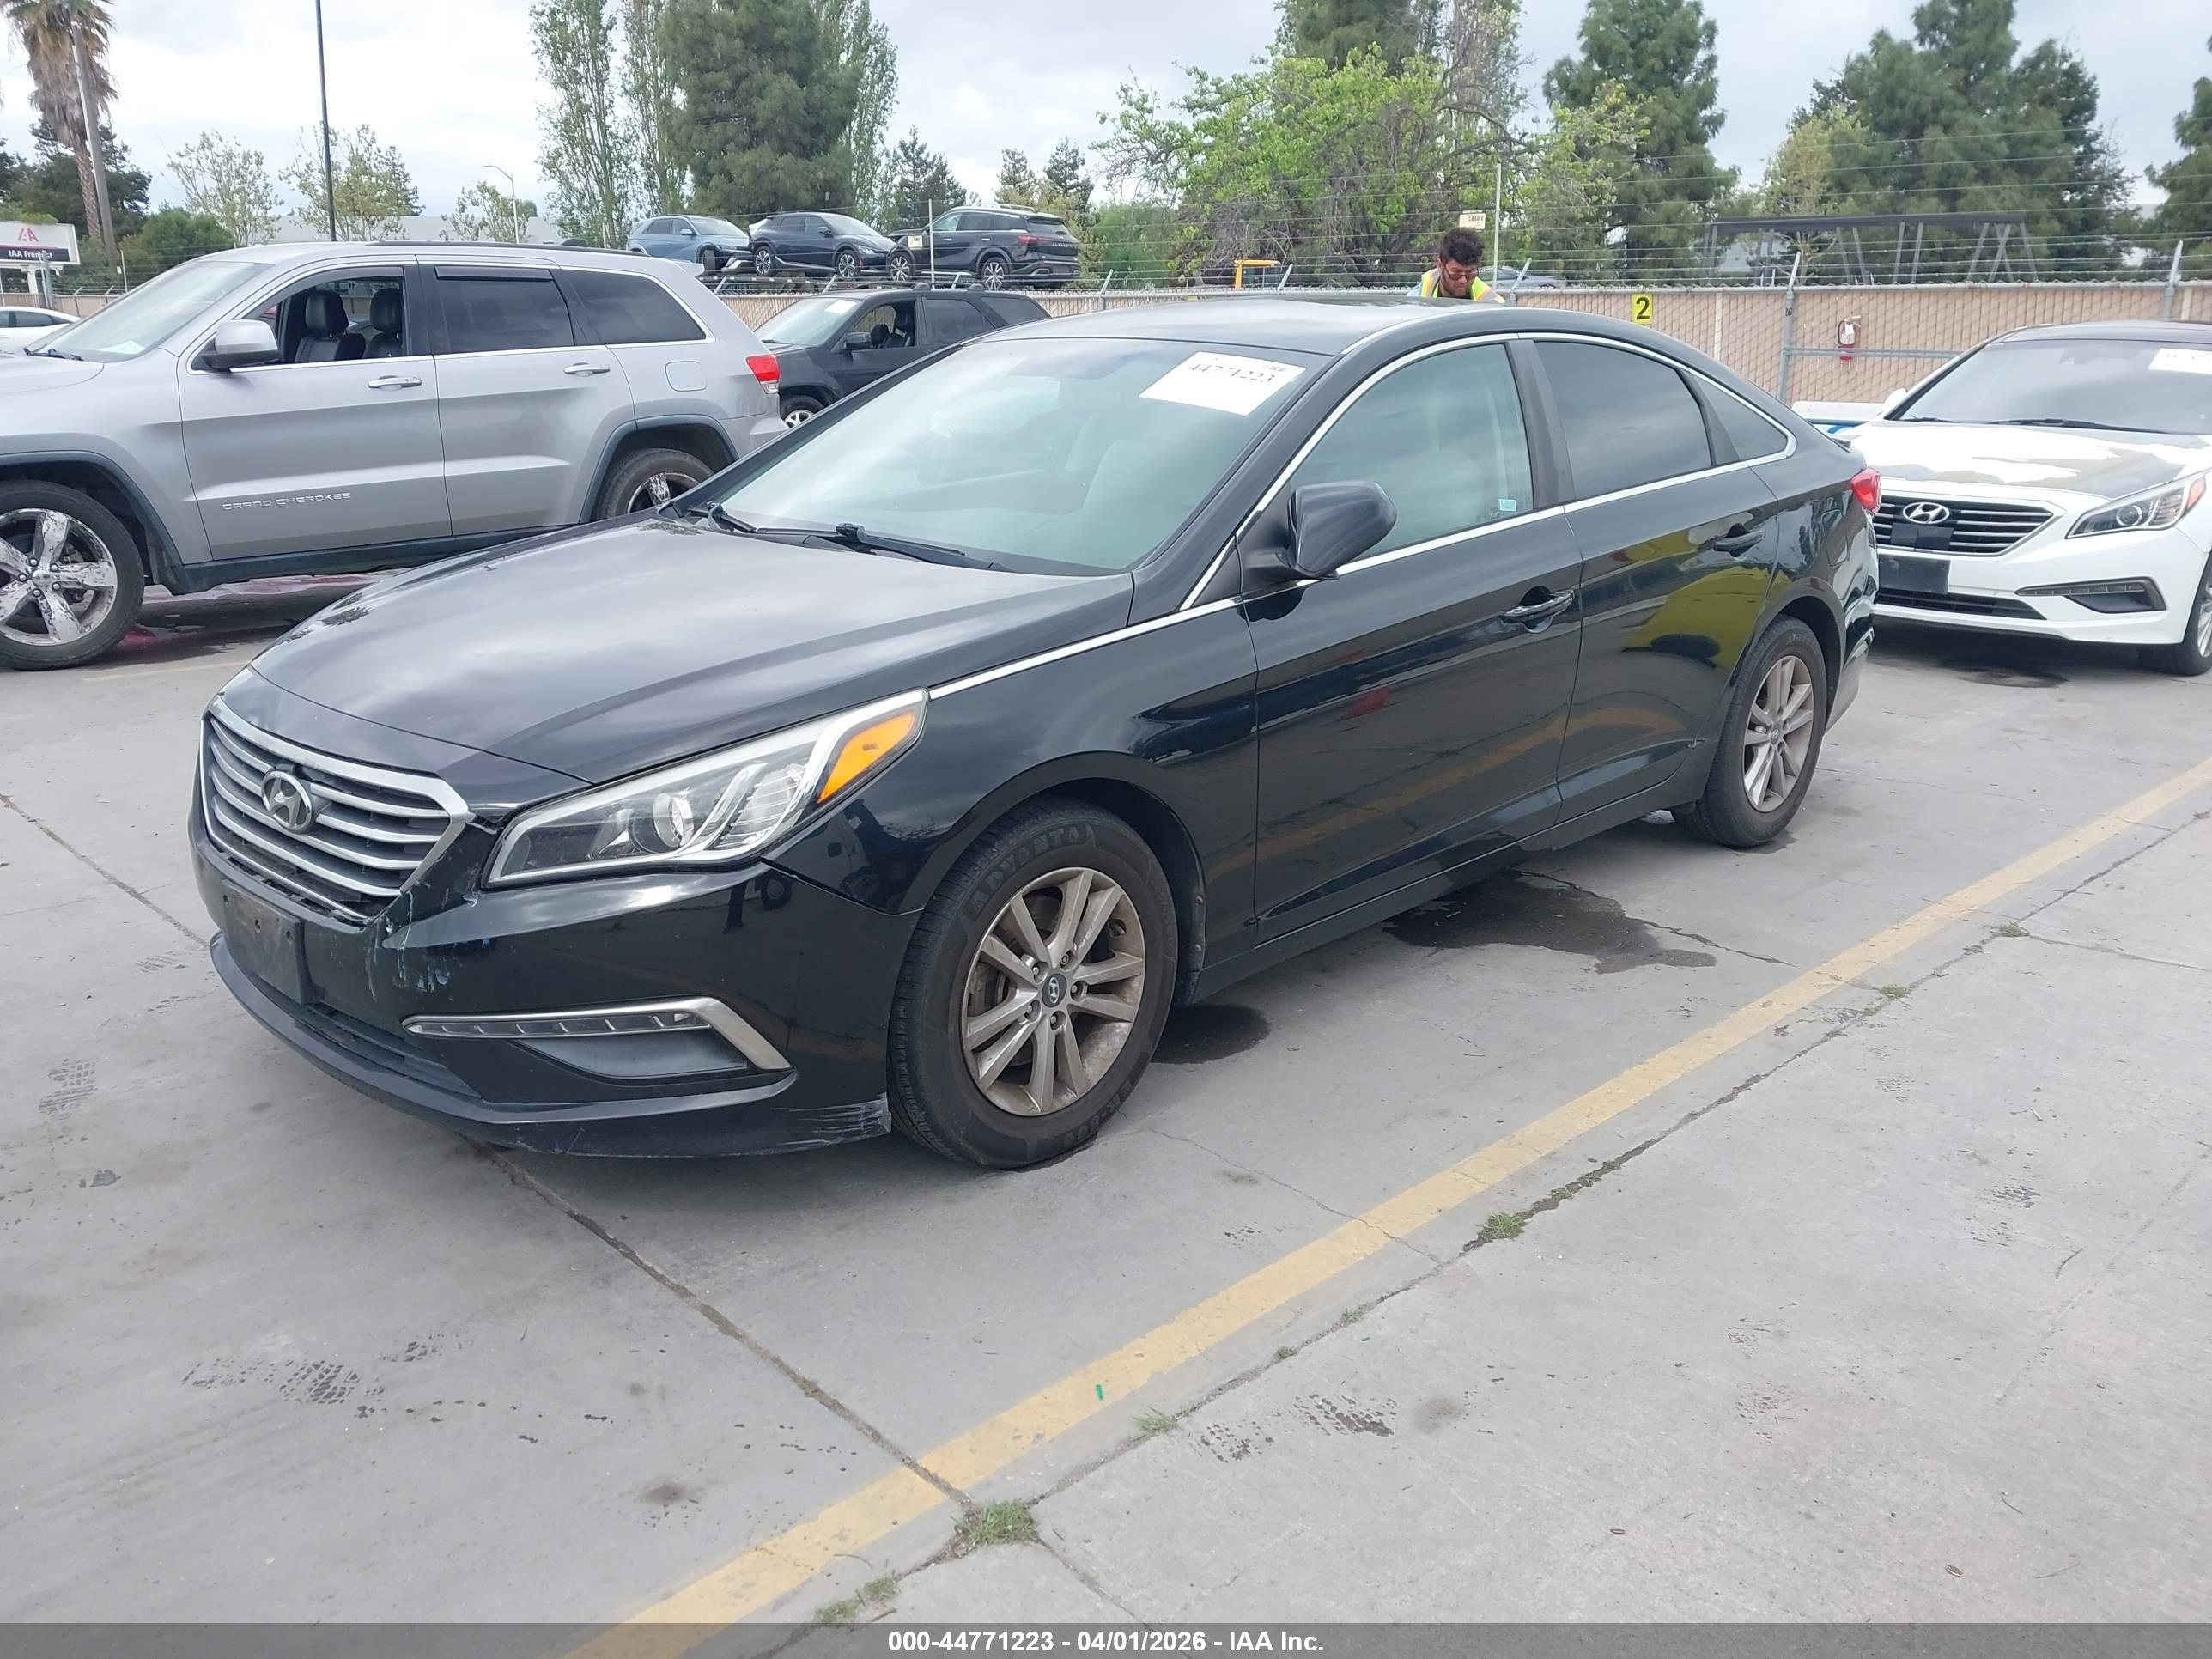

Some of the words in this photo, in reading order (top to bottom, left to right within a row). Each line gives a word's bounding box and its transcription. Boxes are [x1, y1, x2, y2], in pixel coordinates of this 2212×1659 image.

[9, 249, 23, 258] IAA
[23, 250, 53, 259] Fremt
[1636, 296, 1650, 320] 2
[222, 500, 272, 510] GRAND
[276, 492, 351, 505] CHEROKEE
